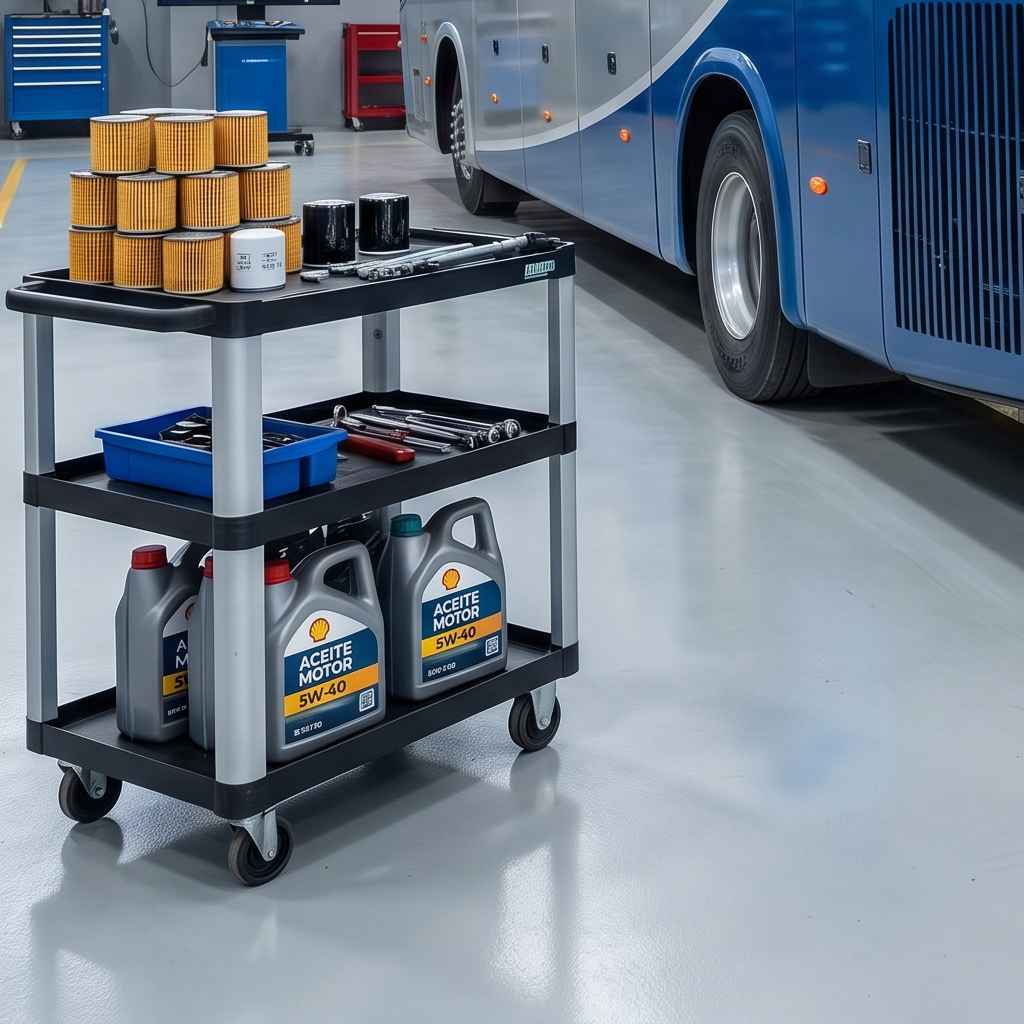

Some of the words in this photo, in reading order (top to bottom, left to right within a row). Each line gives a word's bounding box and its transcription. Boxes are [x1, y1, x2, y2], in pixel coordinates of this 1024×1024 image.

[433, 590, 480, 617] ACEITE
[433, 606, 480, 632] MOTOR
[435, 626, 477, 650] 5W-40
[299, 640, 353, 672] ACEITE
[299, 657, 353, 688] MOTOR
[298, 679, 347, 708] 5W-40
